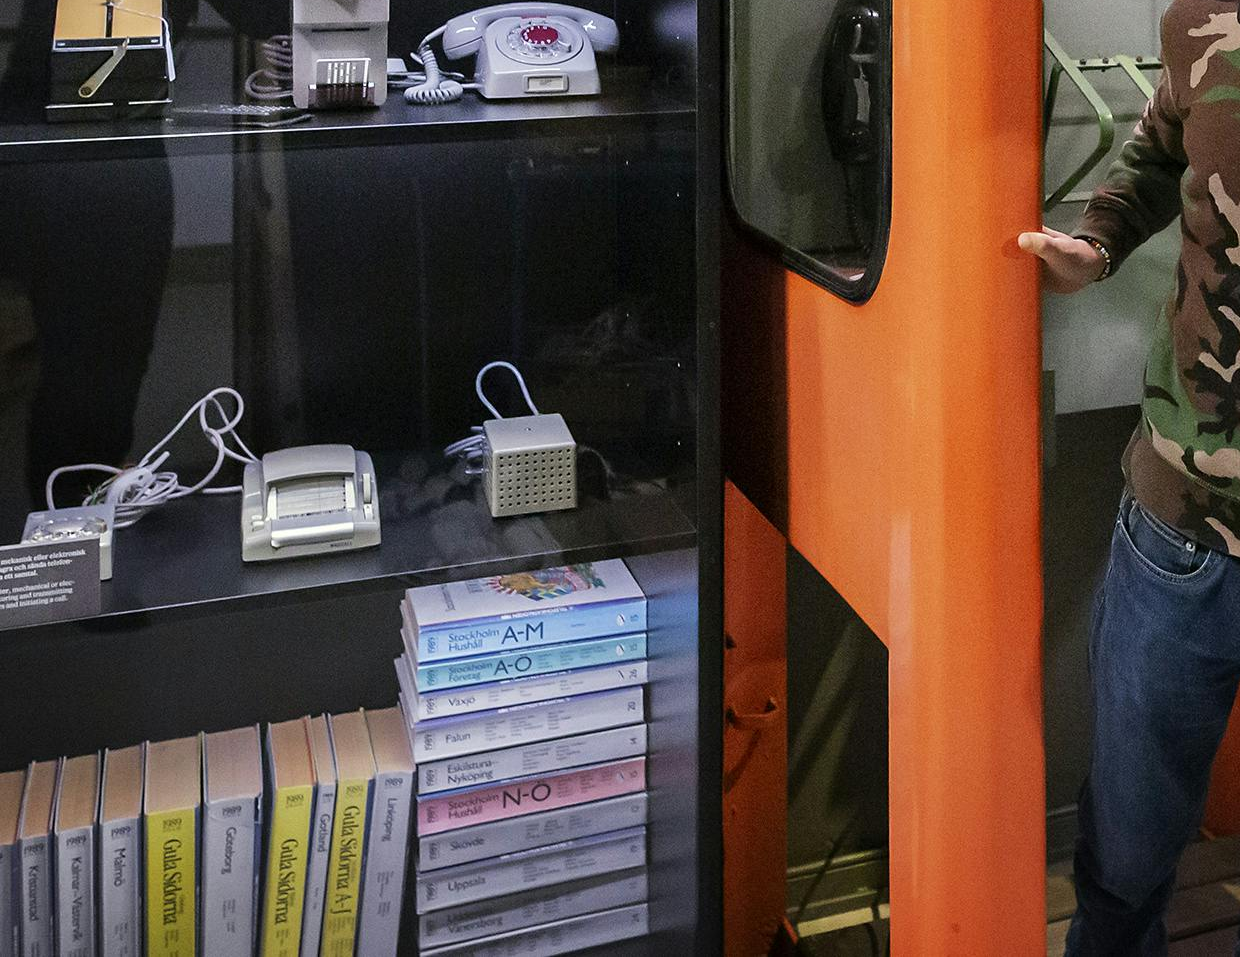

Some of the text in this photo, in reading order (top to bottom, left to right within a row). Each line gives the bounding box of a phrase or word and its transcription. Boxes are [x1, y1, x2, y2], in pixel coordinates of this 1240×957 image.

[448, 627, 499, 642] Stockholm
[501, 621, 544, 645] A-M
[448, 661, 493, 676] Stockholm
[445, 732, 471, 743] Falun
[448, 793, 499, 810] Stockholm
[502, 780, 551, 809] N-Ö
[317, 813, 331, 853] Gotland
[341, 805, 361, 837] Gula
[113, 848, 127, 887] Malmö
[163, 838, 183, 871] Gula
[280, 838, 299, 871] Gula
[336, 837, 357, 890] Sidorna
[163, 871, 183, 926] Sidorna
[275, 871, 296, 925] Sidorna
[447, 875, 486, 893] Uppsala
